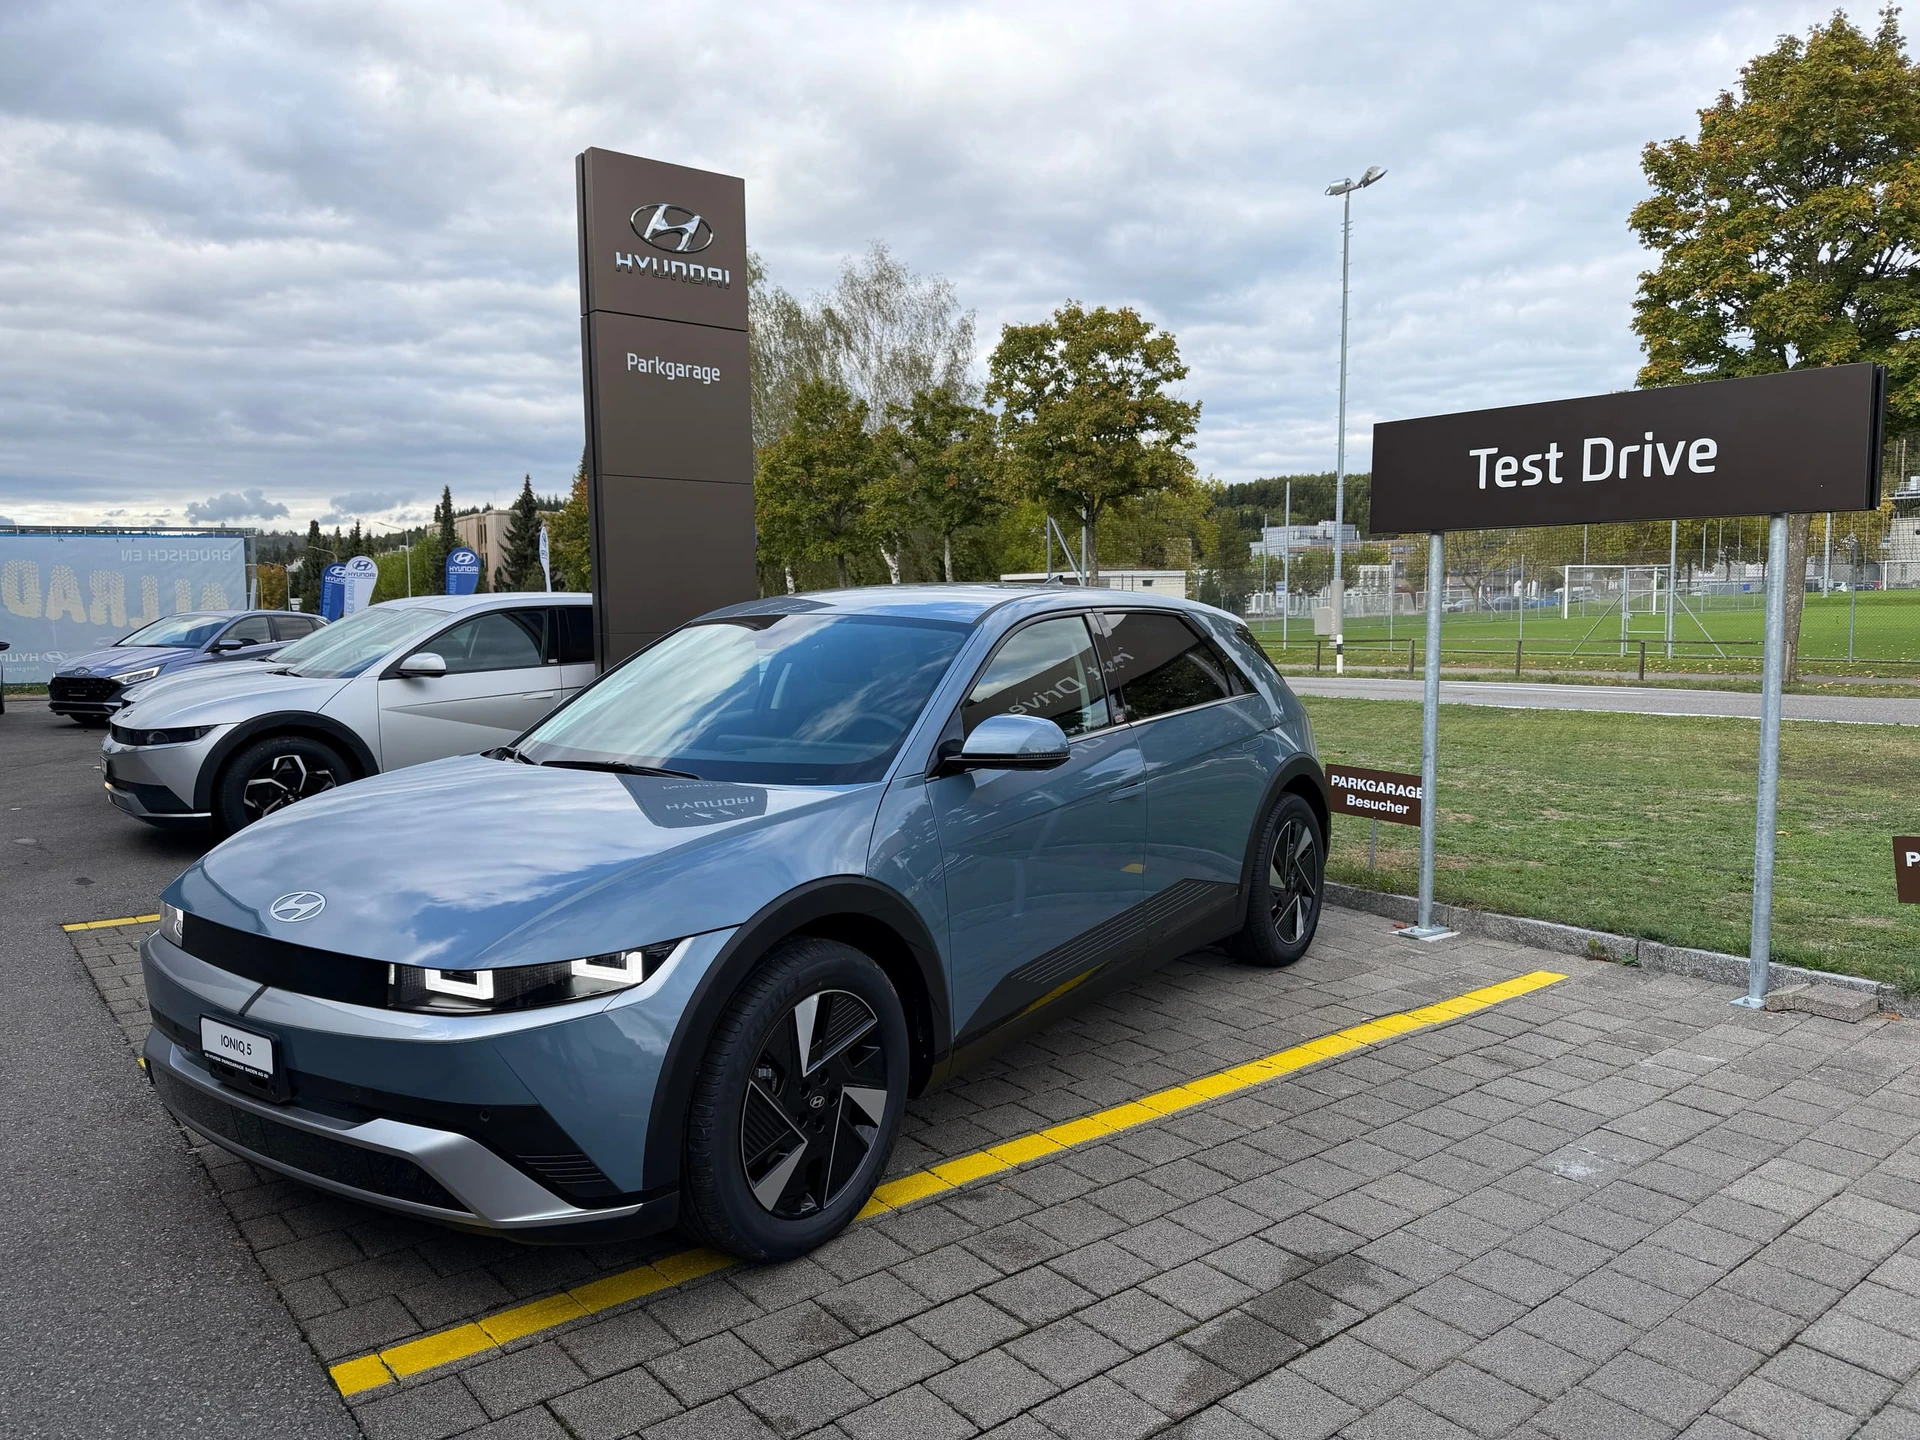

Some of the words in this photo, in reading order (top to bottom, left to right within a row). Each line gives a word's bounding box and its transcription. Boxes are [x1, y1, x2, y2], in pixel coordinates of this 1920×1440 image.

[615, 251, 731, 290] HYUNDAI
[627, 352, 721, 385] Parkgarage
[1469, 442, 1564, 490] Test
[1582, 431, 1718, 482] Drive
[449, 565, 479, 573] HYUNDAI
[449, 575, 457, 595] ADEN
[1330, 774, 1422, 800] PARKGARAGE
[1346, 793, 1410, 815] Besucher
[1905, 850, 1920, 867] P
[220, 1034, 245, 1056] IONIQ
[246, 1043, 252, 1056] 5
